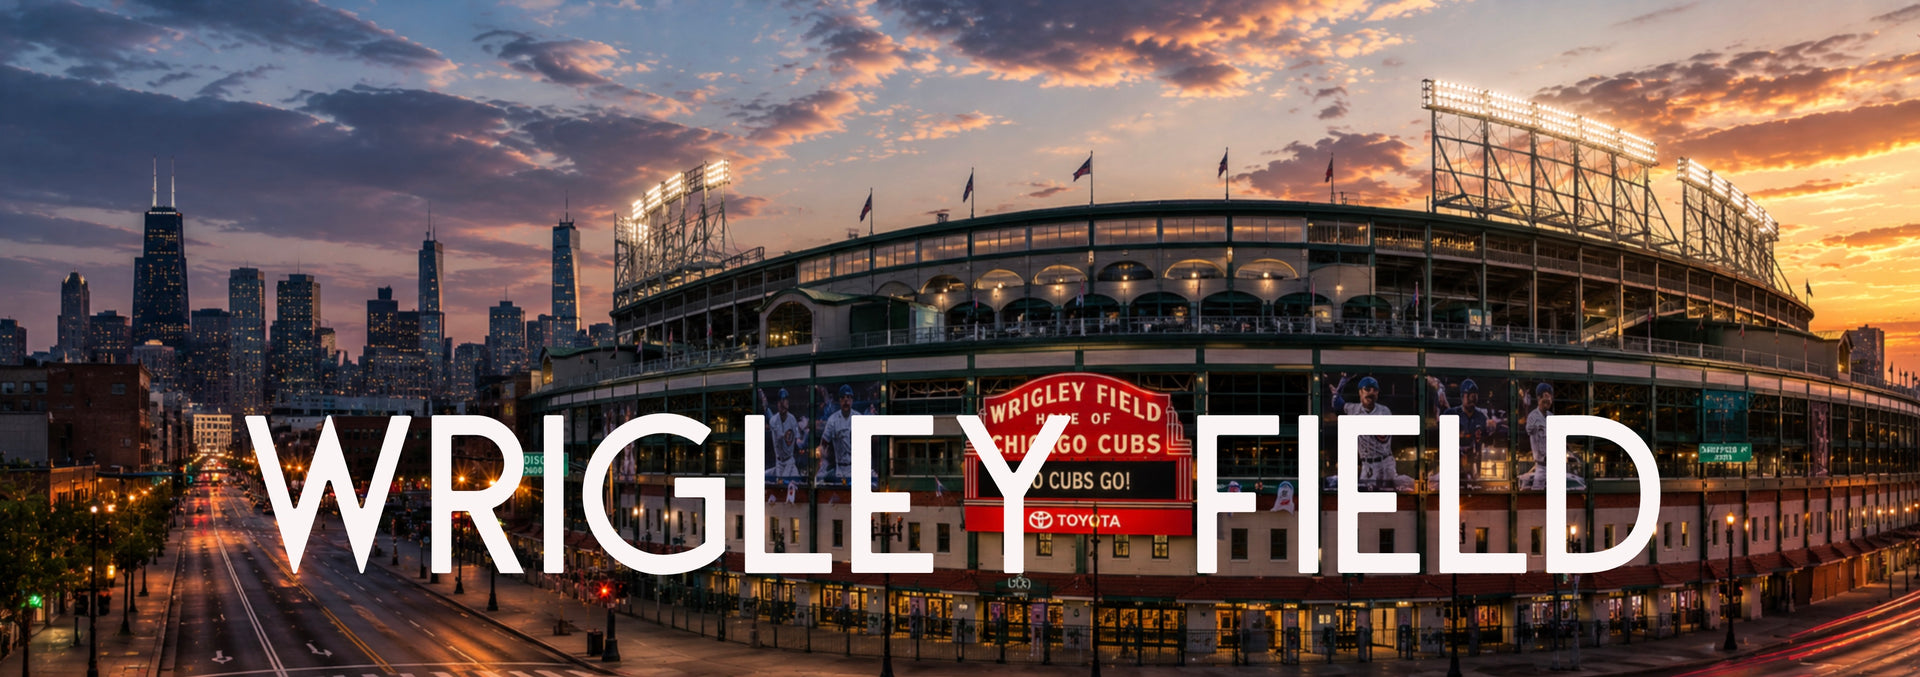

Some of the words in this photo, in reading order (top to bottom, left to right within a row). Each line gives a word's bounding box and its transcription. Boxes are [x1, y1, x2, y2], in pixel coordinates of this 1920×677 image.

[991, 382, 1085, 424] WRIGLEY
[1097, 384, 1162, 422] FIELD
[1036, 413, 1079, 425] HE
[1091, 413, 1111, 425] OF
[992, 434, 1087, 454] CHIGO
[1097, 434, 1161, 454] CUBS
[1049, 471, 1094, 490] CUBS
[1100, 471, 1130, 490] GO!
[1056, 514, 1121, 528] TOYOTA
